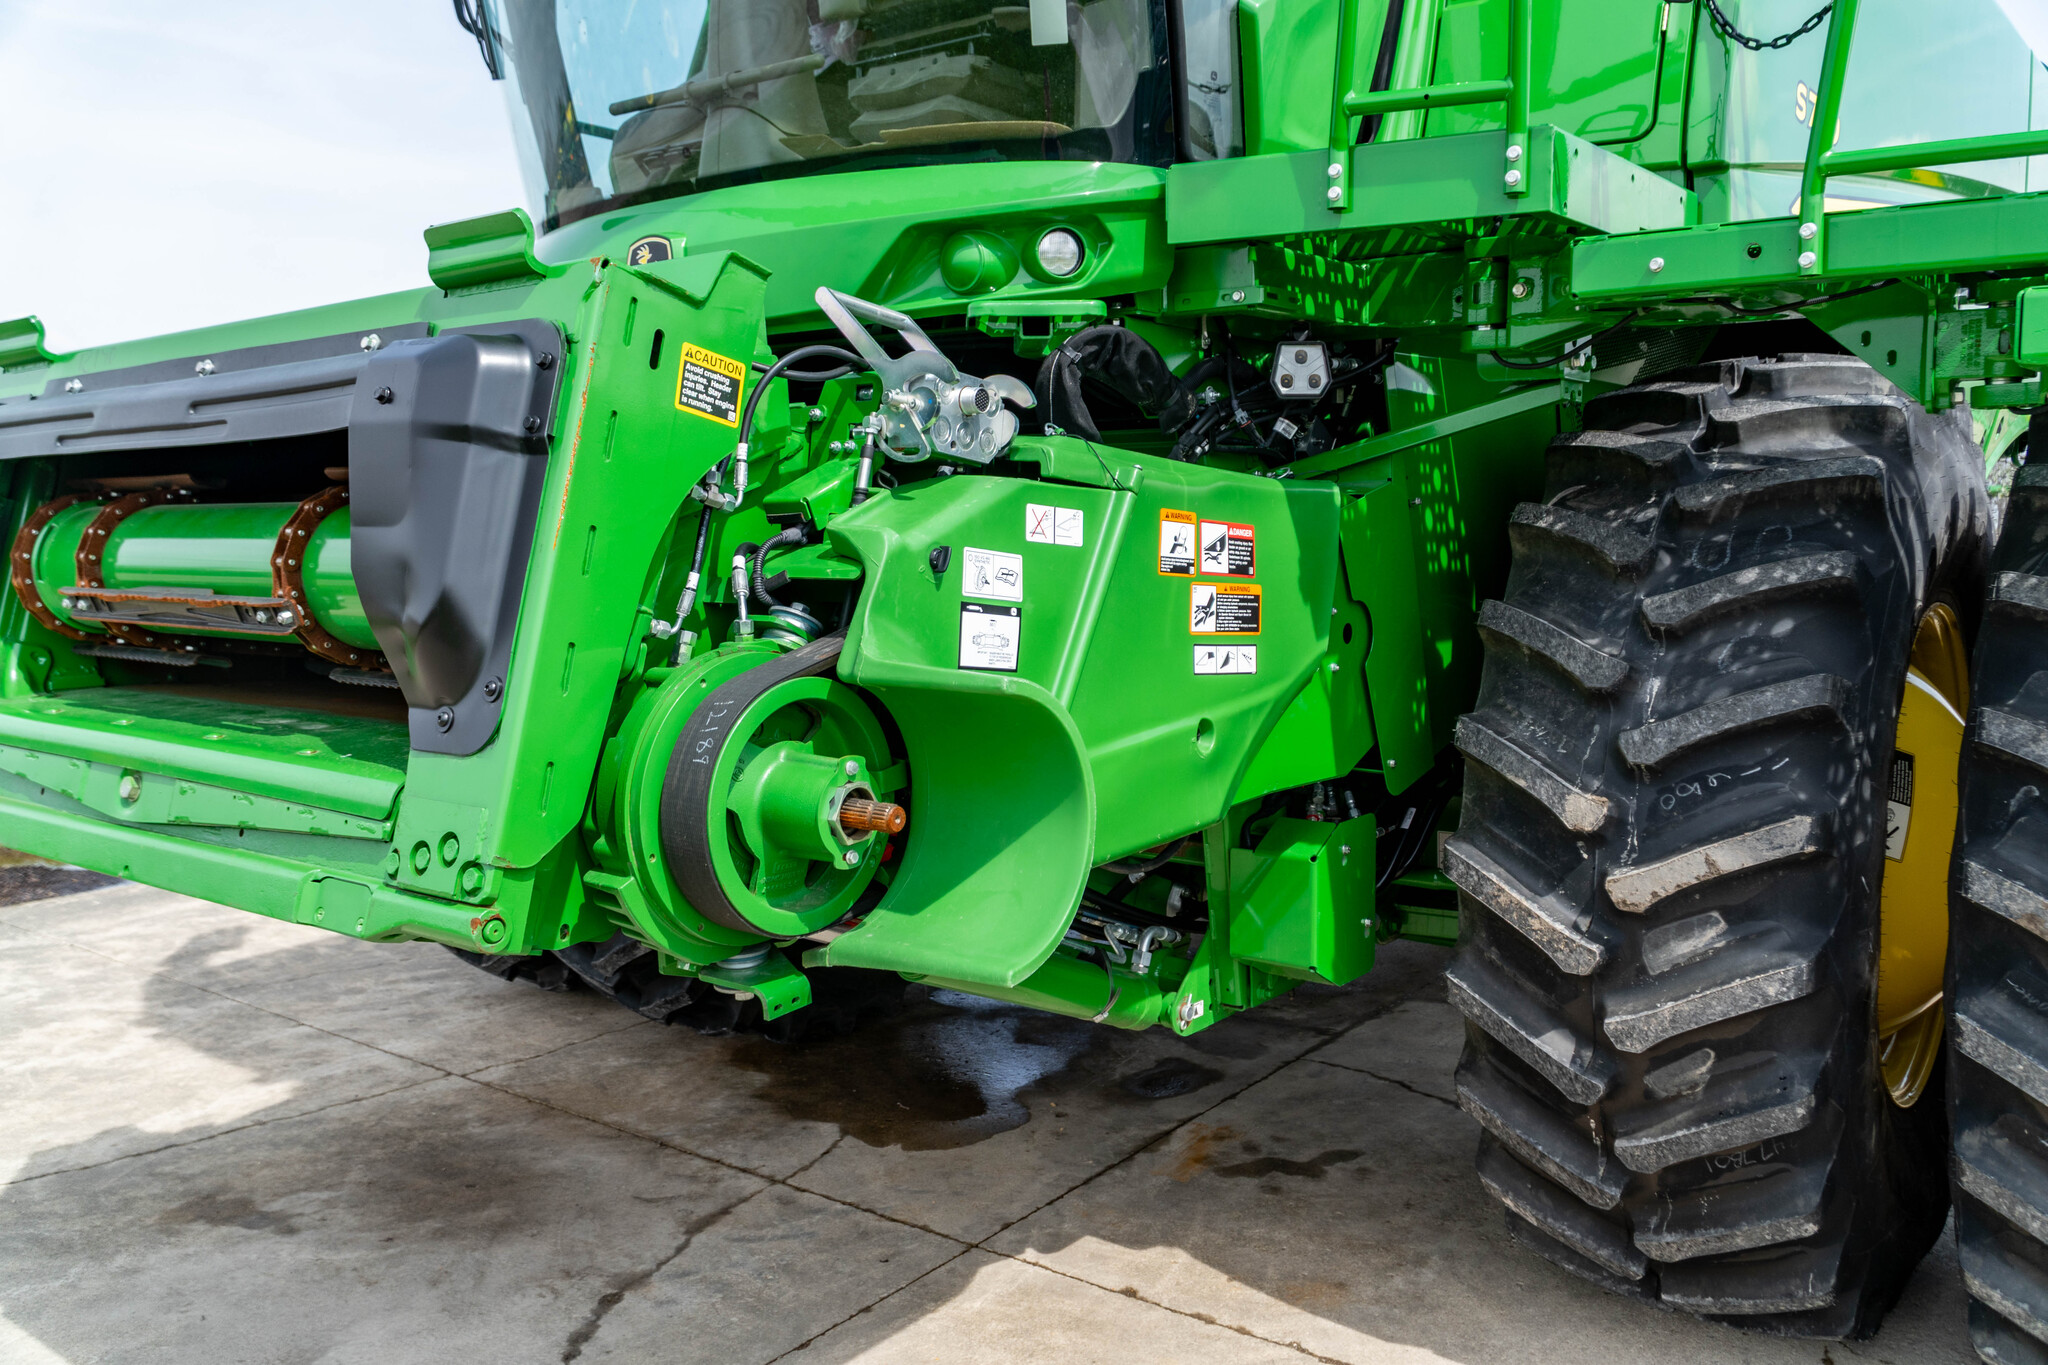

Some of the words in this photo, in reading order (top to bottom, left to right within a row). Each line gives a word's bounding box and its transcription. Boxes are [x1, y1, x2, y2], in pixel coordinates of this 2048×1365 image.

[695, 350, 742, 376] CAUTION
[684, 371, 708, 385] injuries.
[711, 380, 732, 393] Header
[685, 363, 704, 374] Avoid
[704, 369, 730, 385] crushing
[683, 380, 695, 389] can
[708, 387, 721, 399] Stay
[681, 395, 688, 403] is
[688, 398, 713, 412] running.
[682, 388, 698, 398] clear
[698, 393, 715, 403] when
[715, 399, 735, 411] engine
[1171, 513, 1192, 521] WARNING
[1233, 528, 1253, 537] DANGER
[1229, 585, 1251, 593] WARNING
